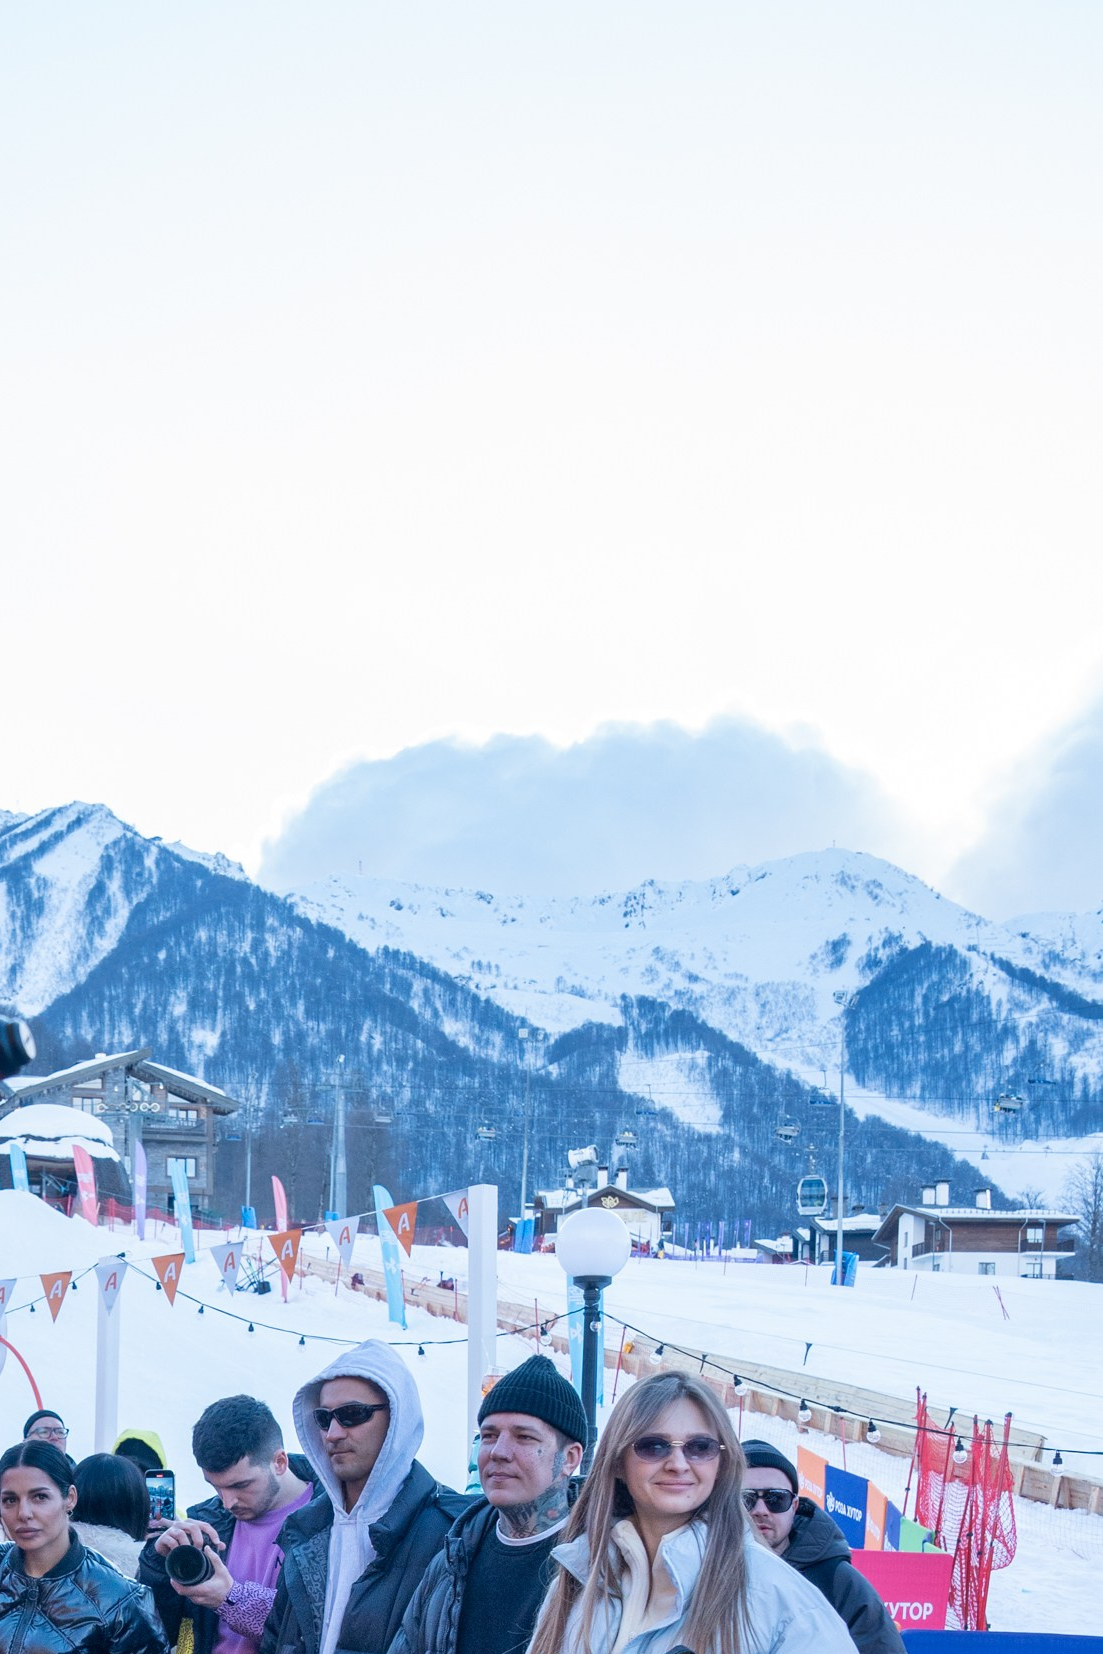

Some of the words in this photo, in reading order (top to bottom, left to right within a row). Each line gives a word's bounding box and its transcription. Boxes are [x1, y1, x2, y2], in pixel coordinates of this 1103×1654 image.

[398, 1212, 411, 1234] A
[339, 1226, 351, 1247] A
[281, 1239, 294, 1261] A
[163, 1262, 176, 1283] A
[224, 1251, 236, 1273] A
[49, 1279, 62, 1299] A
[104, 1272, 118, 1292] A
[834, 1500, 847, 1516] РОЗА
[847, 1504, 863, 1522] ХУТОР
[884, 1601, 933, 1621] УТОР
